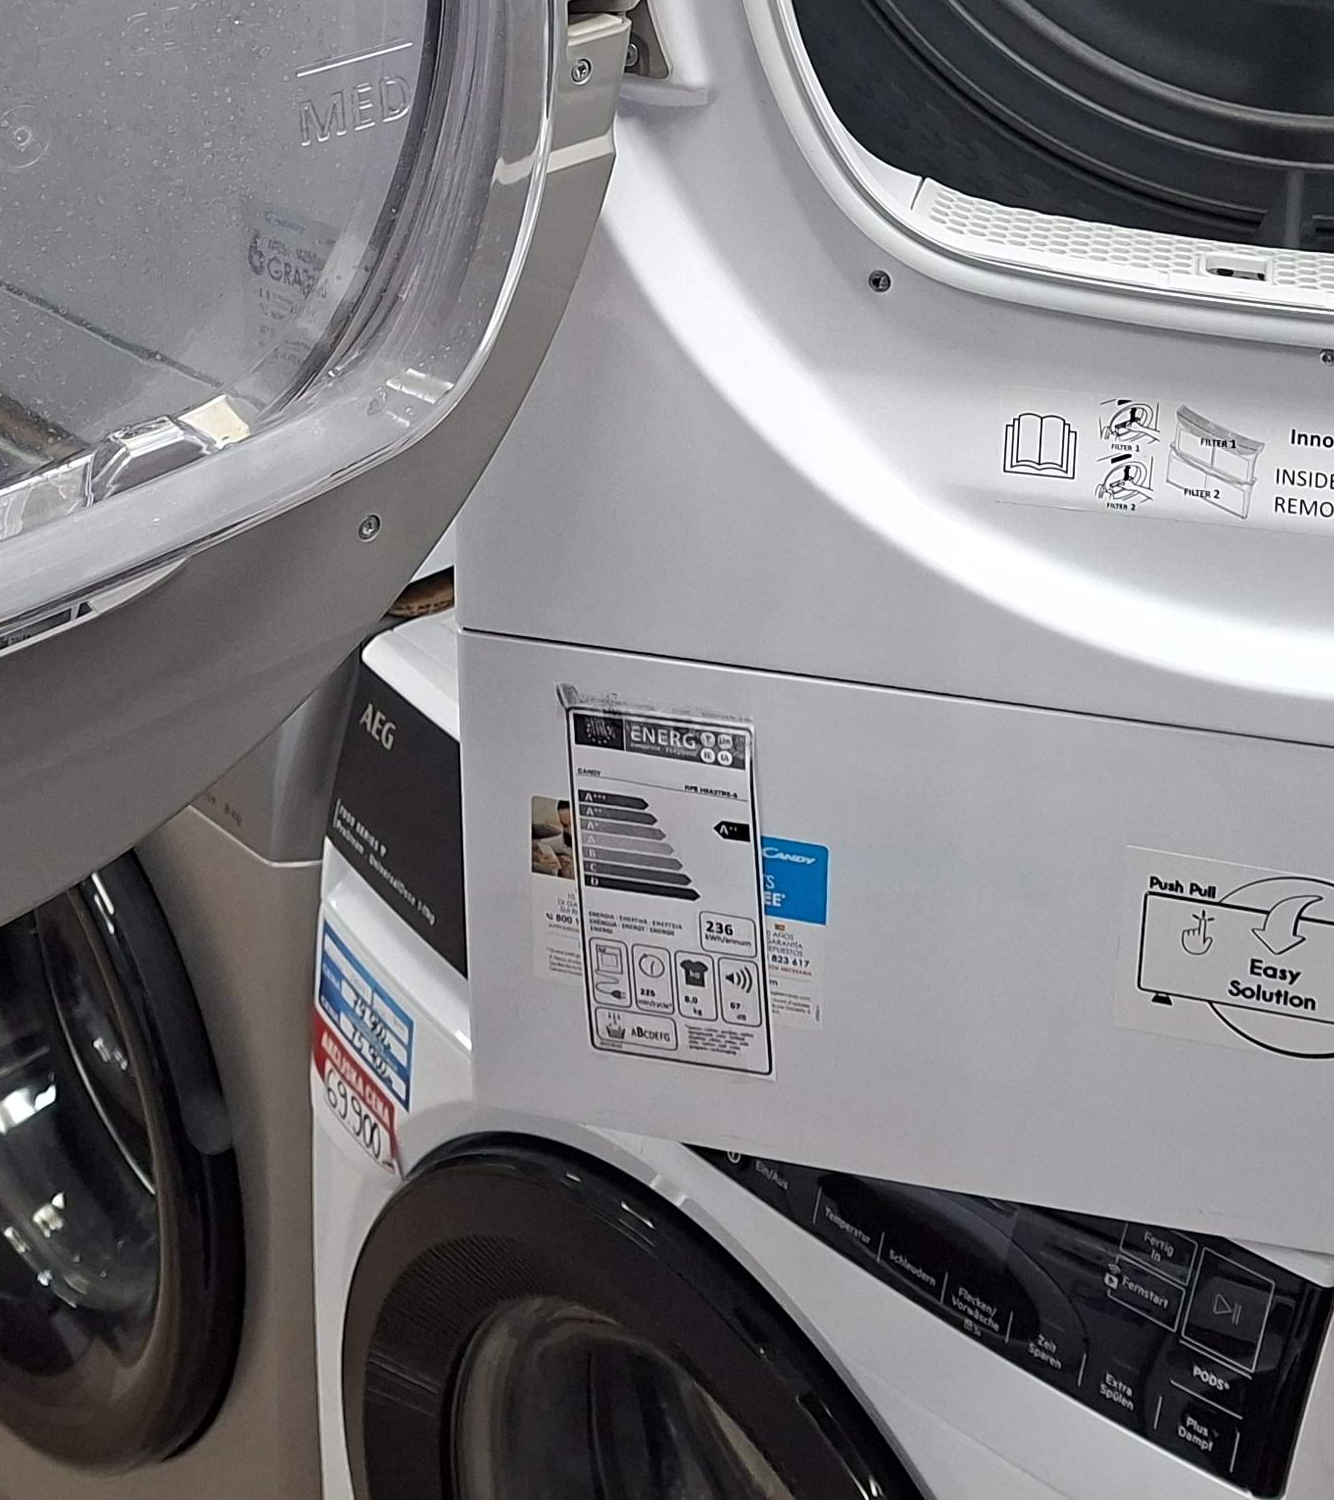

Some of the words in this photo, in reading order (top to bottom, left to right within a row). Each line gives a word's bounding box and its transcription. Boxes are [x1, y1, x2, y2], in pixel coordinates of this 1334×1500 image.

[299, 74, 412, 147] MED
[1111, 443, 1133, 451] FILTER
[1200, 438, 1228, 449] FILTER
[1230, 440, 1236, 449] 1
[1184, 488, 1211, 499] FILTER
[1214, 490, 1220, 500] 2
[1106, 502, 1129, 511] FILTER
[359, 703, 397, 750] AEG
[630, 725, 696, 749] ENERG
[577, 767, 602, 777] CANDY
[719, 825, 738, 836] A++
[589, 863, 597, 872] C
[762, 846, 816, 865] CANDY
[590, 877, 599, 886] D
[1149, 875, 1184, 895] Push
[1189, 882, 1217, 899] Pull
[705, 920, 734, 936] 236
[705, 933, 752, 947] kWh/annum
[1249, 958, 1301, 986] Easy
[1227, 980, 1317, 1011] Solution
[755, 1160, 789, 1191] Ein/Aus
[824, 1206, 871, 1244] Temperatur
[1143, 1230, 1175, 1258] Fertig
[889, 1248, 937, 1287] Schleudern
[1122, 1275, 1169, 1309] Fernstart
[950, 1293, 1000, 1333] Vorwäsche
[1037, 1333, 1057, 1354] Zeit
[1028, 1342, 1062, 1370] Sparen
[1105, 1372, 1133, 1397] Extra
[1099, 1382, 1135, 1412] Spülen
[1177, 1425, 1214, 1452] Dampf
[1186, 1416, 1209, 1437] Plus
